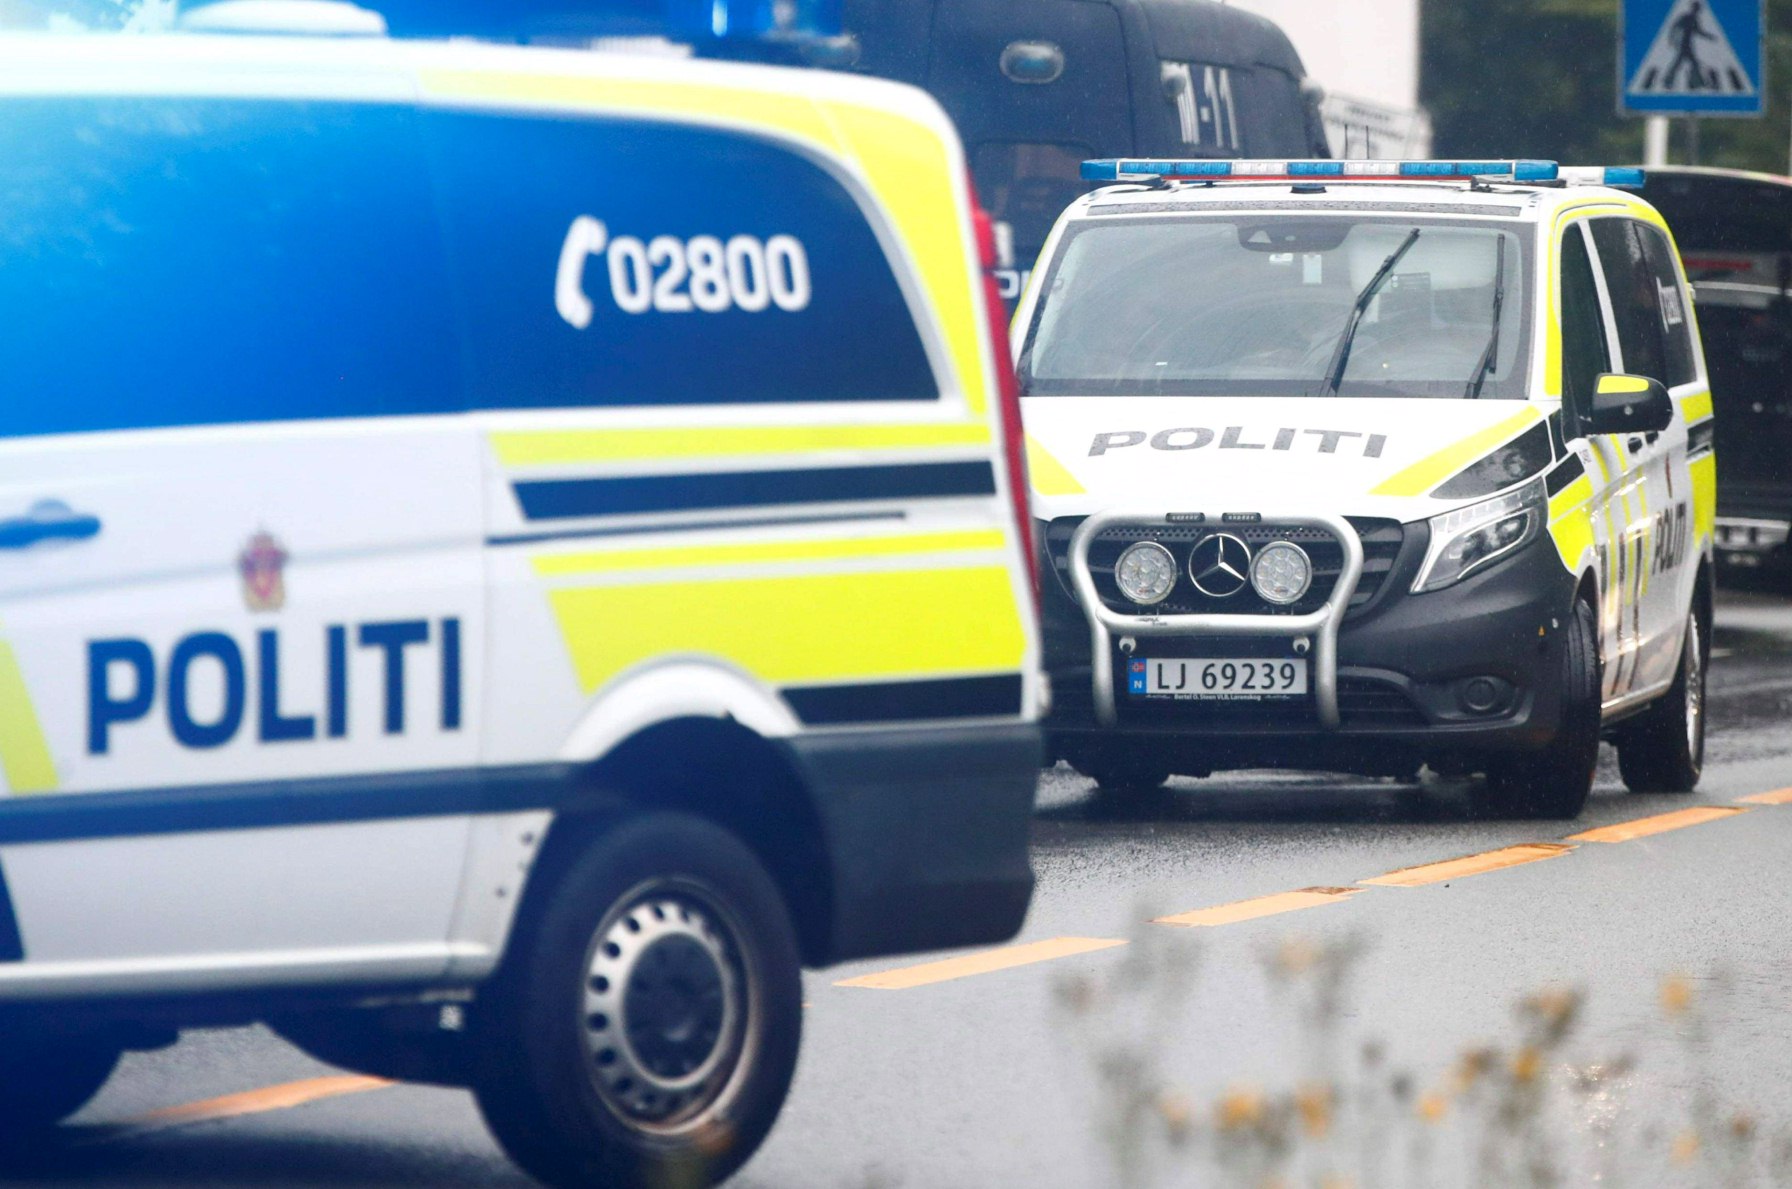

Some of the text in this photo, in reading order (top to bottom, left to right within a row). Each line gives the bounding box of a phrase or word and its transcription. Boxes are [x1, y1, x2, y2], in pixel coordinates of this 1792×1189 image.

[607, 235, 811, 313] 02800
[1088, 426, 1387, 458] POLITI
[86, 616, 461, 757] POLITI
[1134, 680, 1142, 689] N
[1157, 663, 1296, 690] LJ 69239
